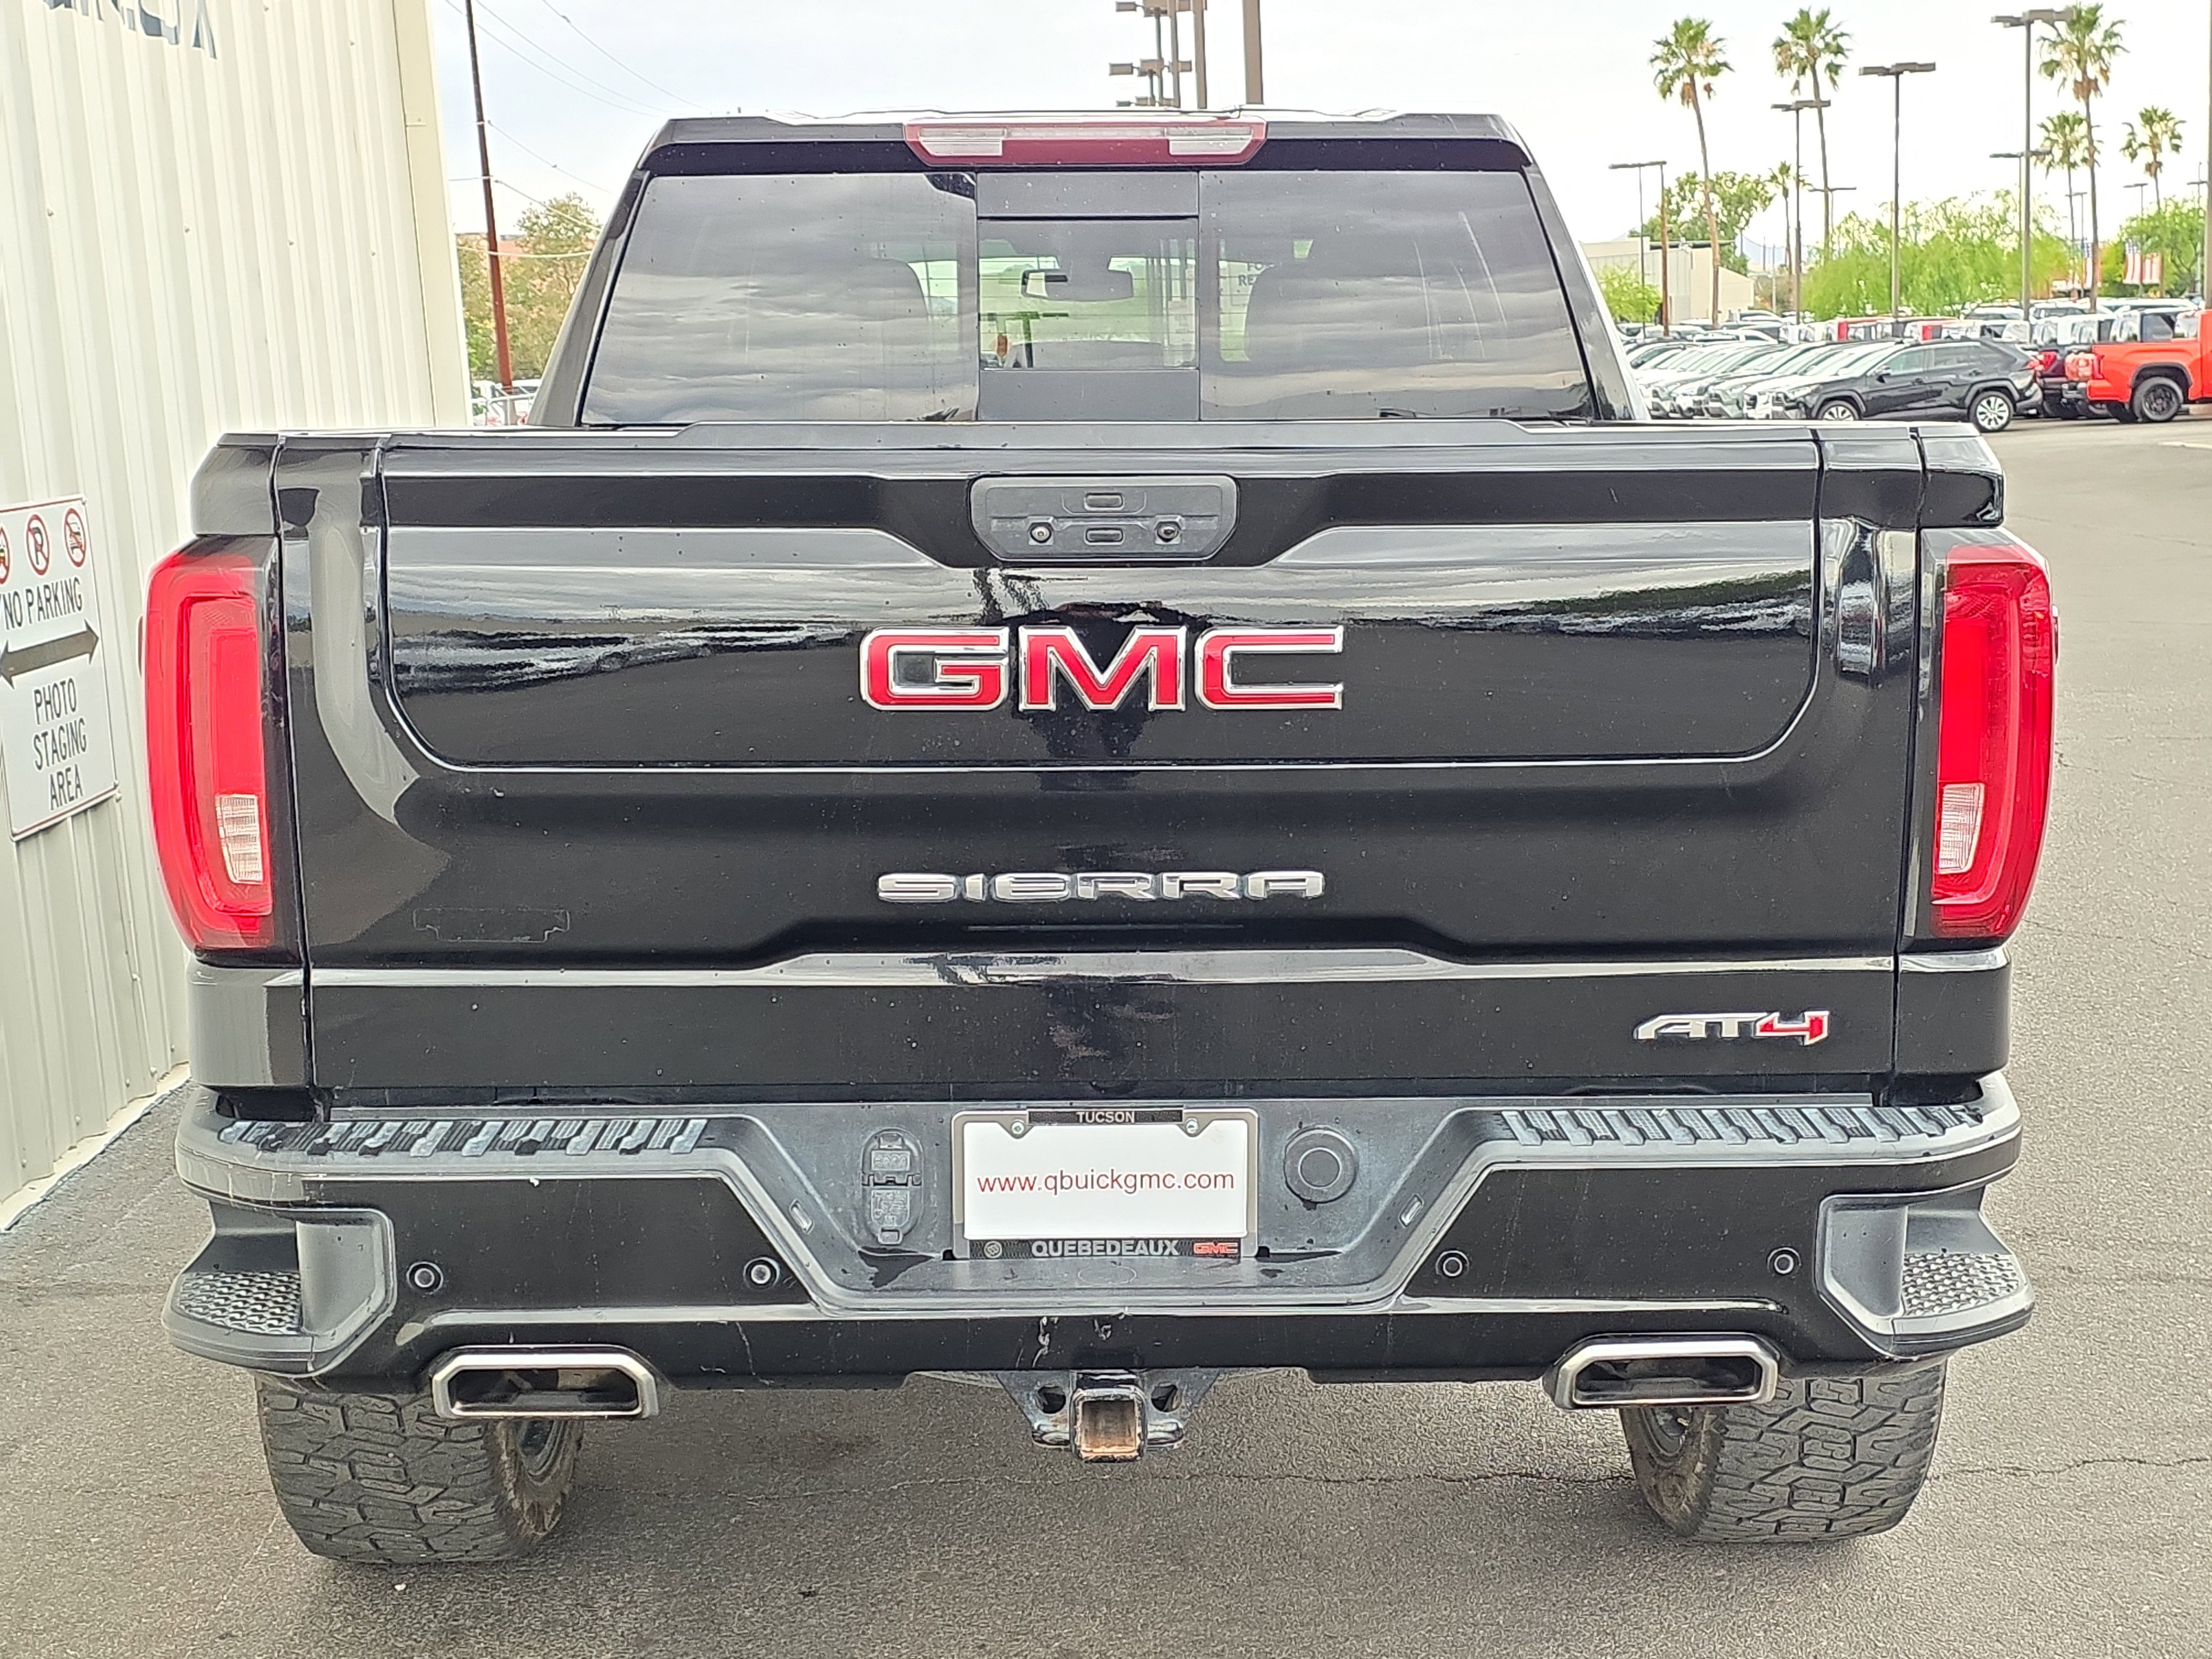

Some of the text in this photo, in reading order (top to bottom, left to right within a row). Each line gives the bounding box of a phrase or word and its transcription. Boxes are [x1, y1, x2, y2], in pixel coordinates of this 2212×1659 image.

[3, 576, 82, 630] NO PARKING
[860, 625, 1344, 711] GMC
[34, 678, 76, 725] PHOTO
[33, 717, 87, 771] STAGING
[49, 763, 83, 811] AREA
[877, 871, 1324, 901] SIERRA
[1634, 1011, 1830, 1046] AT4
[1076, 1111, 1135, 1123] TUCSON
[976, 1168, 1235, 1195] www.qbuickgmc.com
[1031, 1240, 1239, 1257] QUEBEDEAUX GMC
